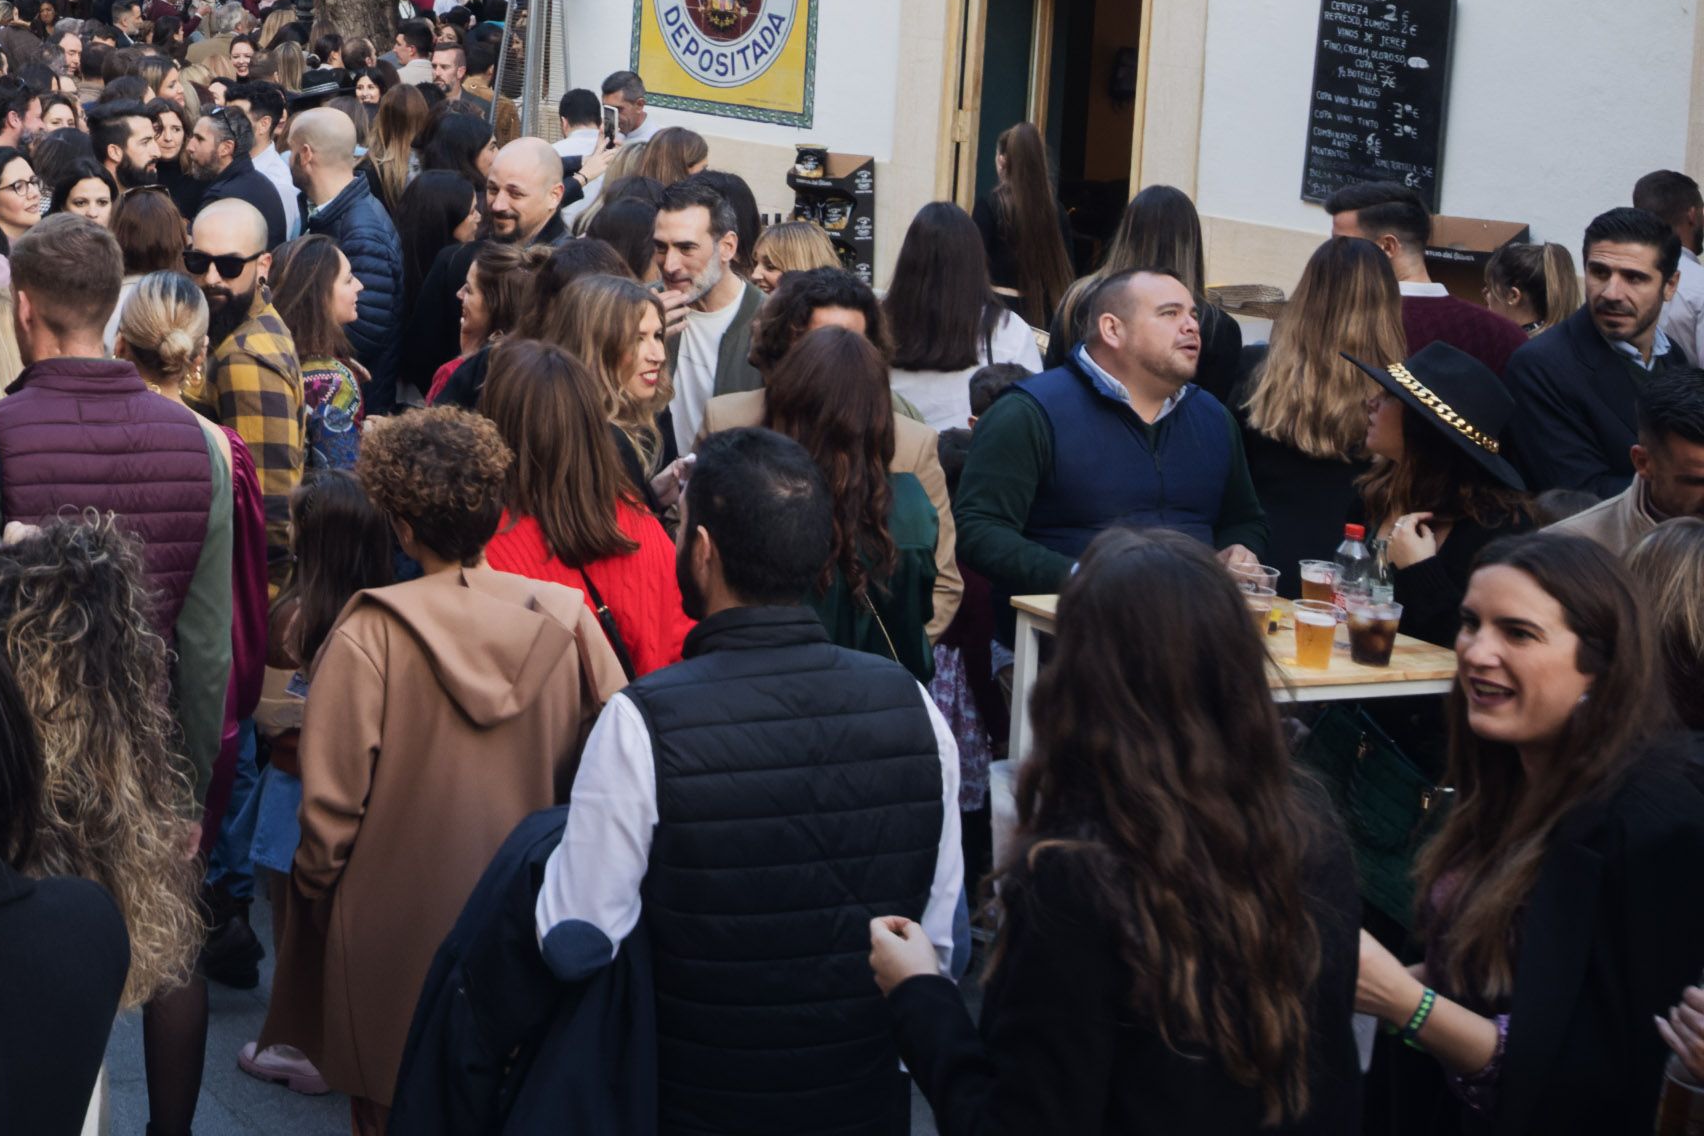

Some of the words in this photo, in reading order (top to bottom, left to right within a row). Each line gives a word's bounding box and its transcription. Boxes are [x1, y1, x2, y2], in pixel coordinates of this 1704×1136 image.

[1331, 0, 1369, 15] CERVEZA
[663, 5, 786, 77] DEPOSITADA
[1337, 27, 1359, 39] VINOS
[1379, 35, 1407, 49] JEREZ
